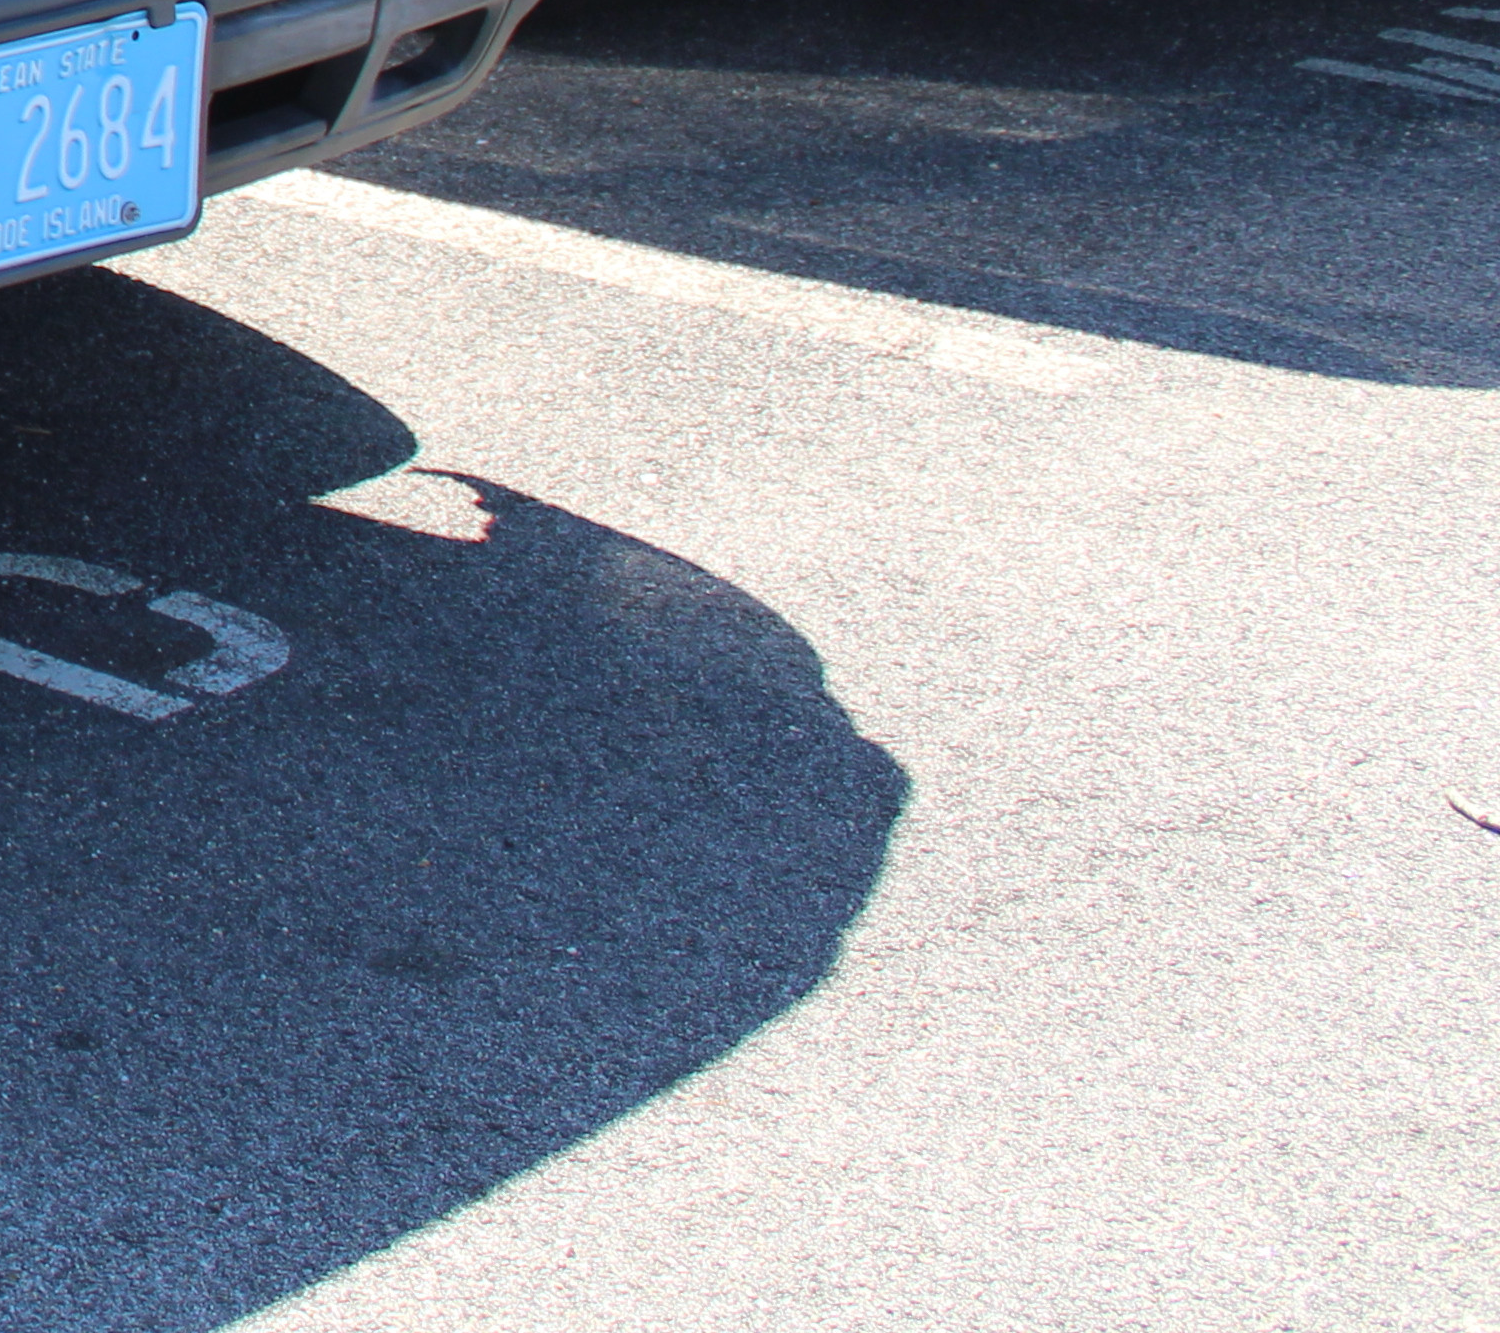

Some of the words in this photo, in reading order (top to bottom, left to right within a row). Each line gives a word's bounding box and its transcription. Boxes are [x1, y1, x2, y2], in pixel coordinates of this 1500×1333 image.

[59, 36, 128, 79] STATE
[16, 65, 178, 203] 2684
[43, 194, 122, 240] ISLAND
